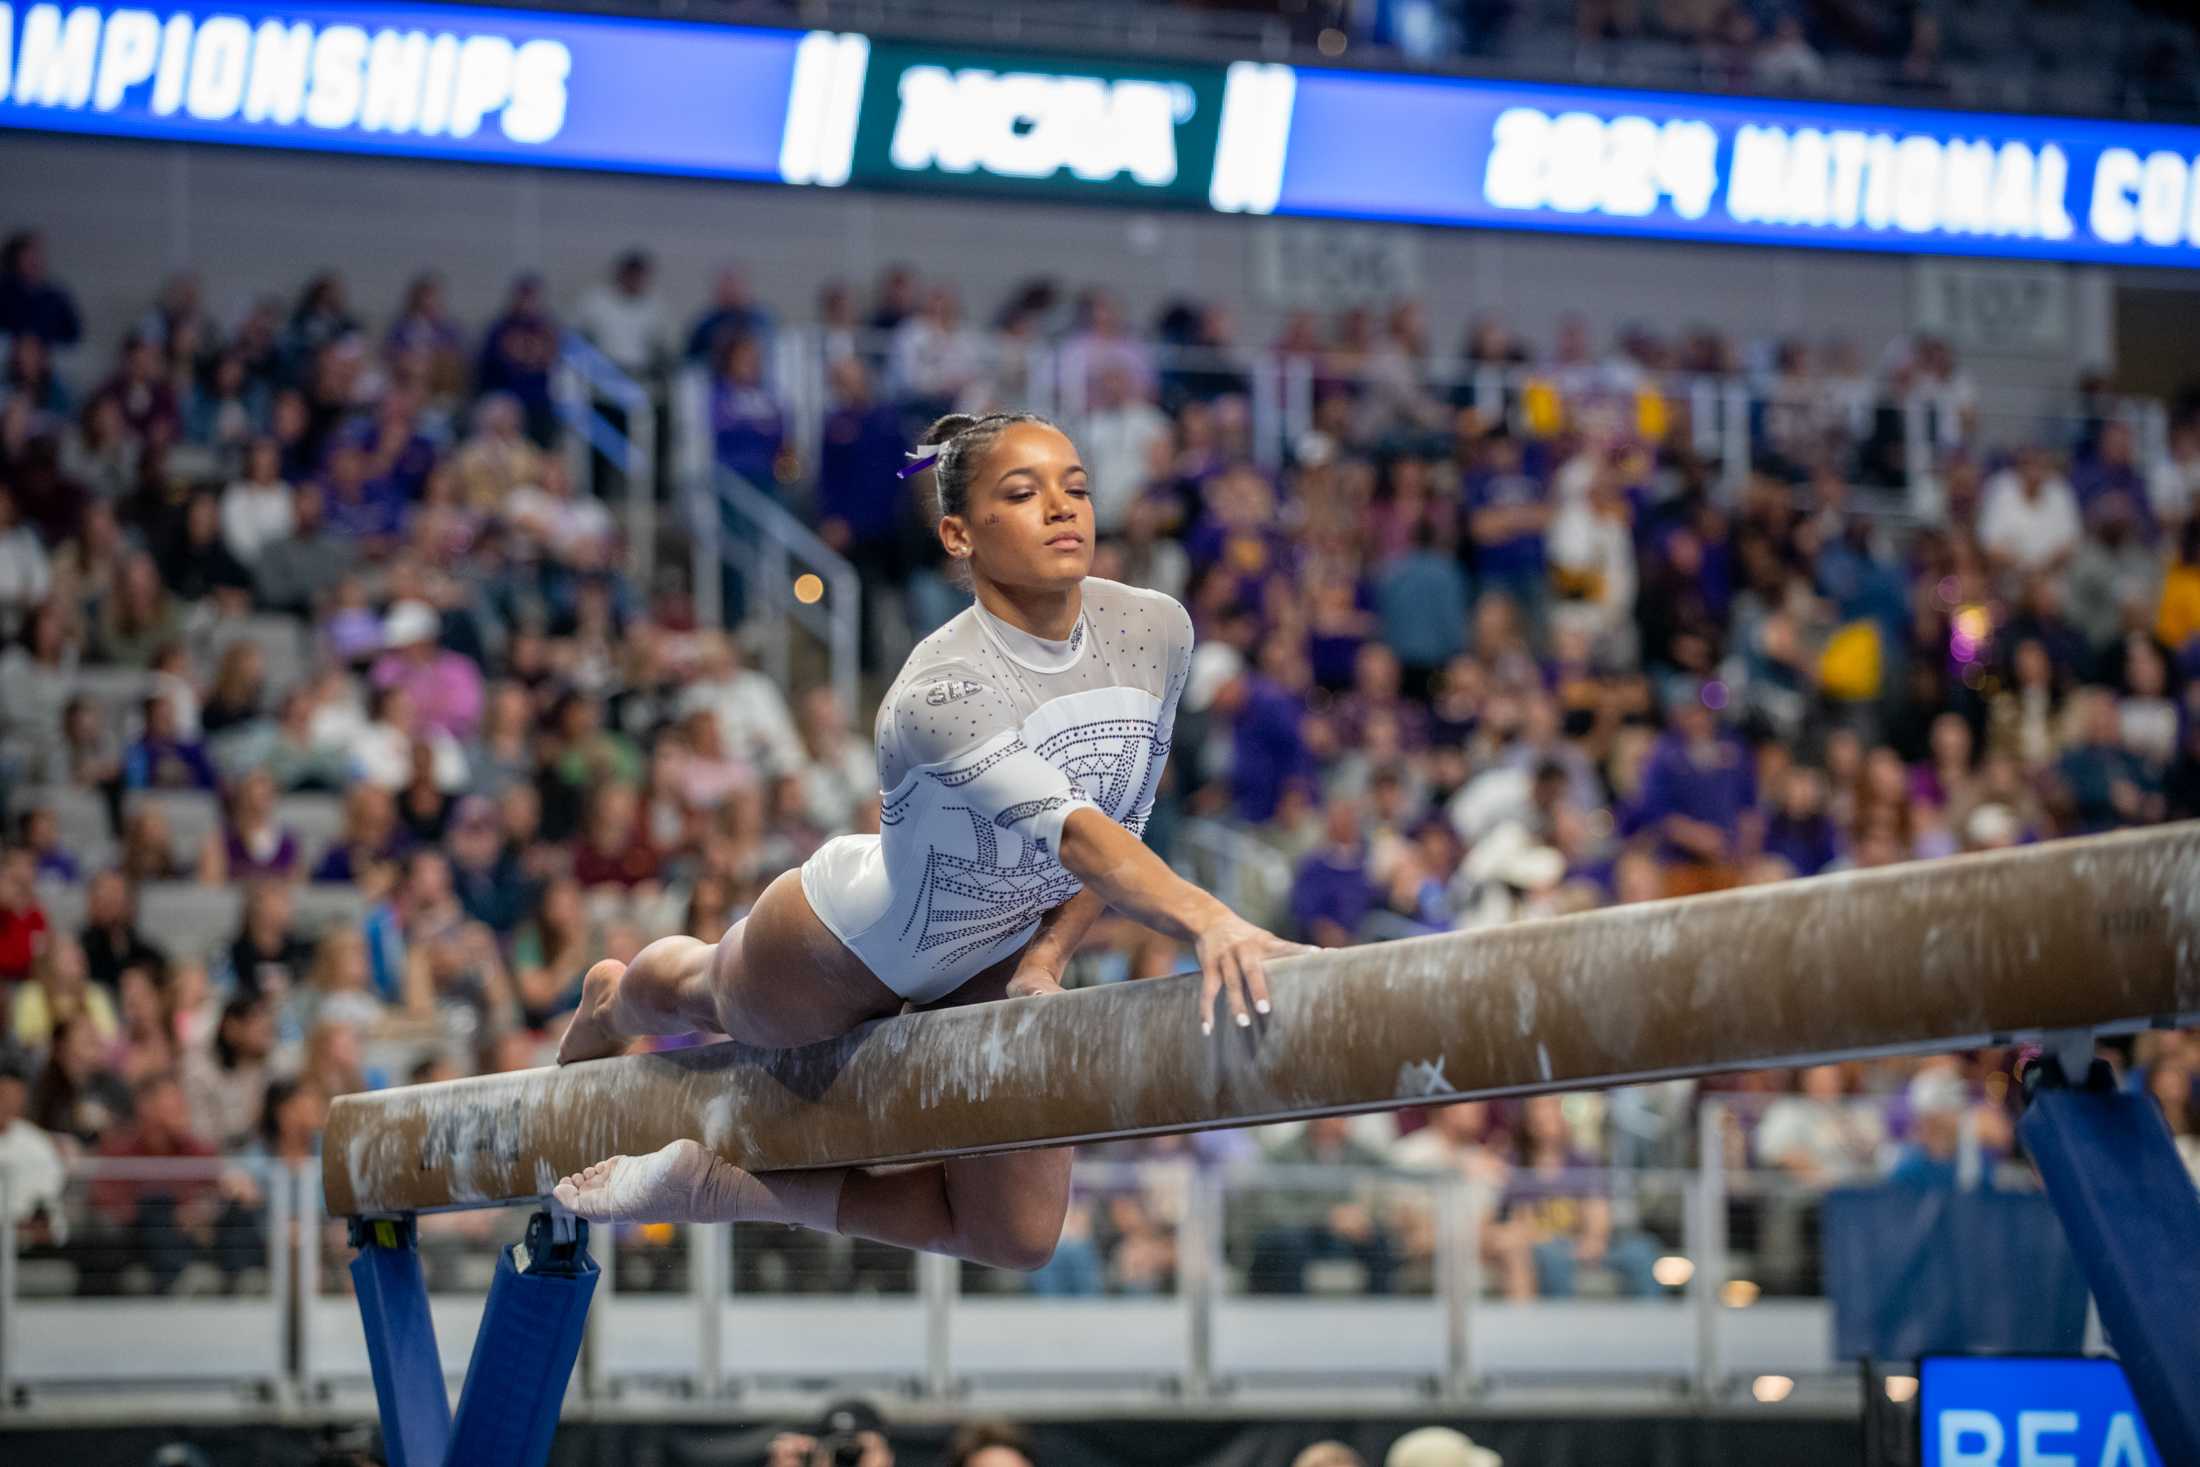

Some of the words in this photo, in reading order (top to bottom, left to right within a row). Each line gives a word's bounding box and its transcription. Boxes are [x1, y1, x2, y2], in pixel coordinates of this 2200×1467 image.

[0, 4, 571, 143] MPIONSHIPS
[892, 67, 1178, 187] NCAA
[1484, 108, 1718, 219] 2024
[1727, 124, 2074, 240] NATIONAL
[2090, 149, 2200, 249] CO
